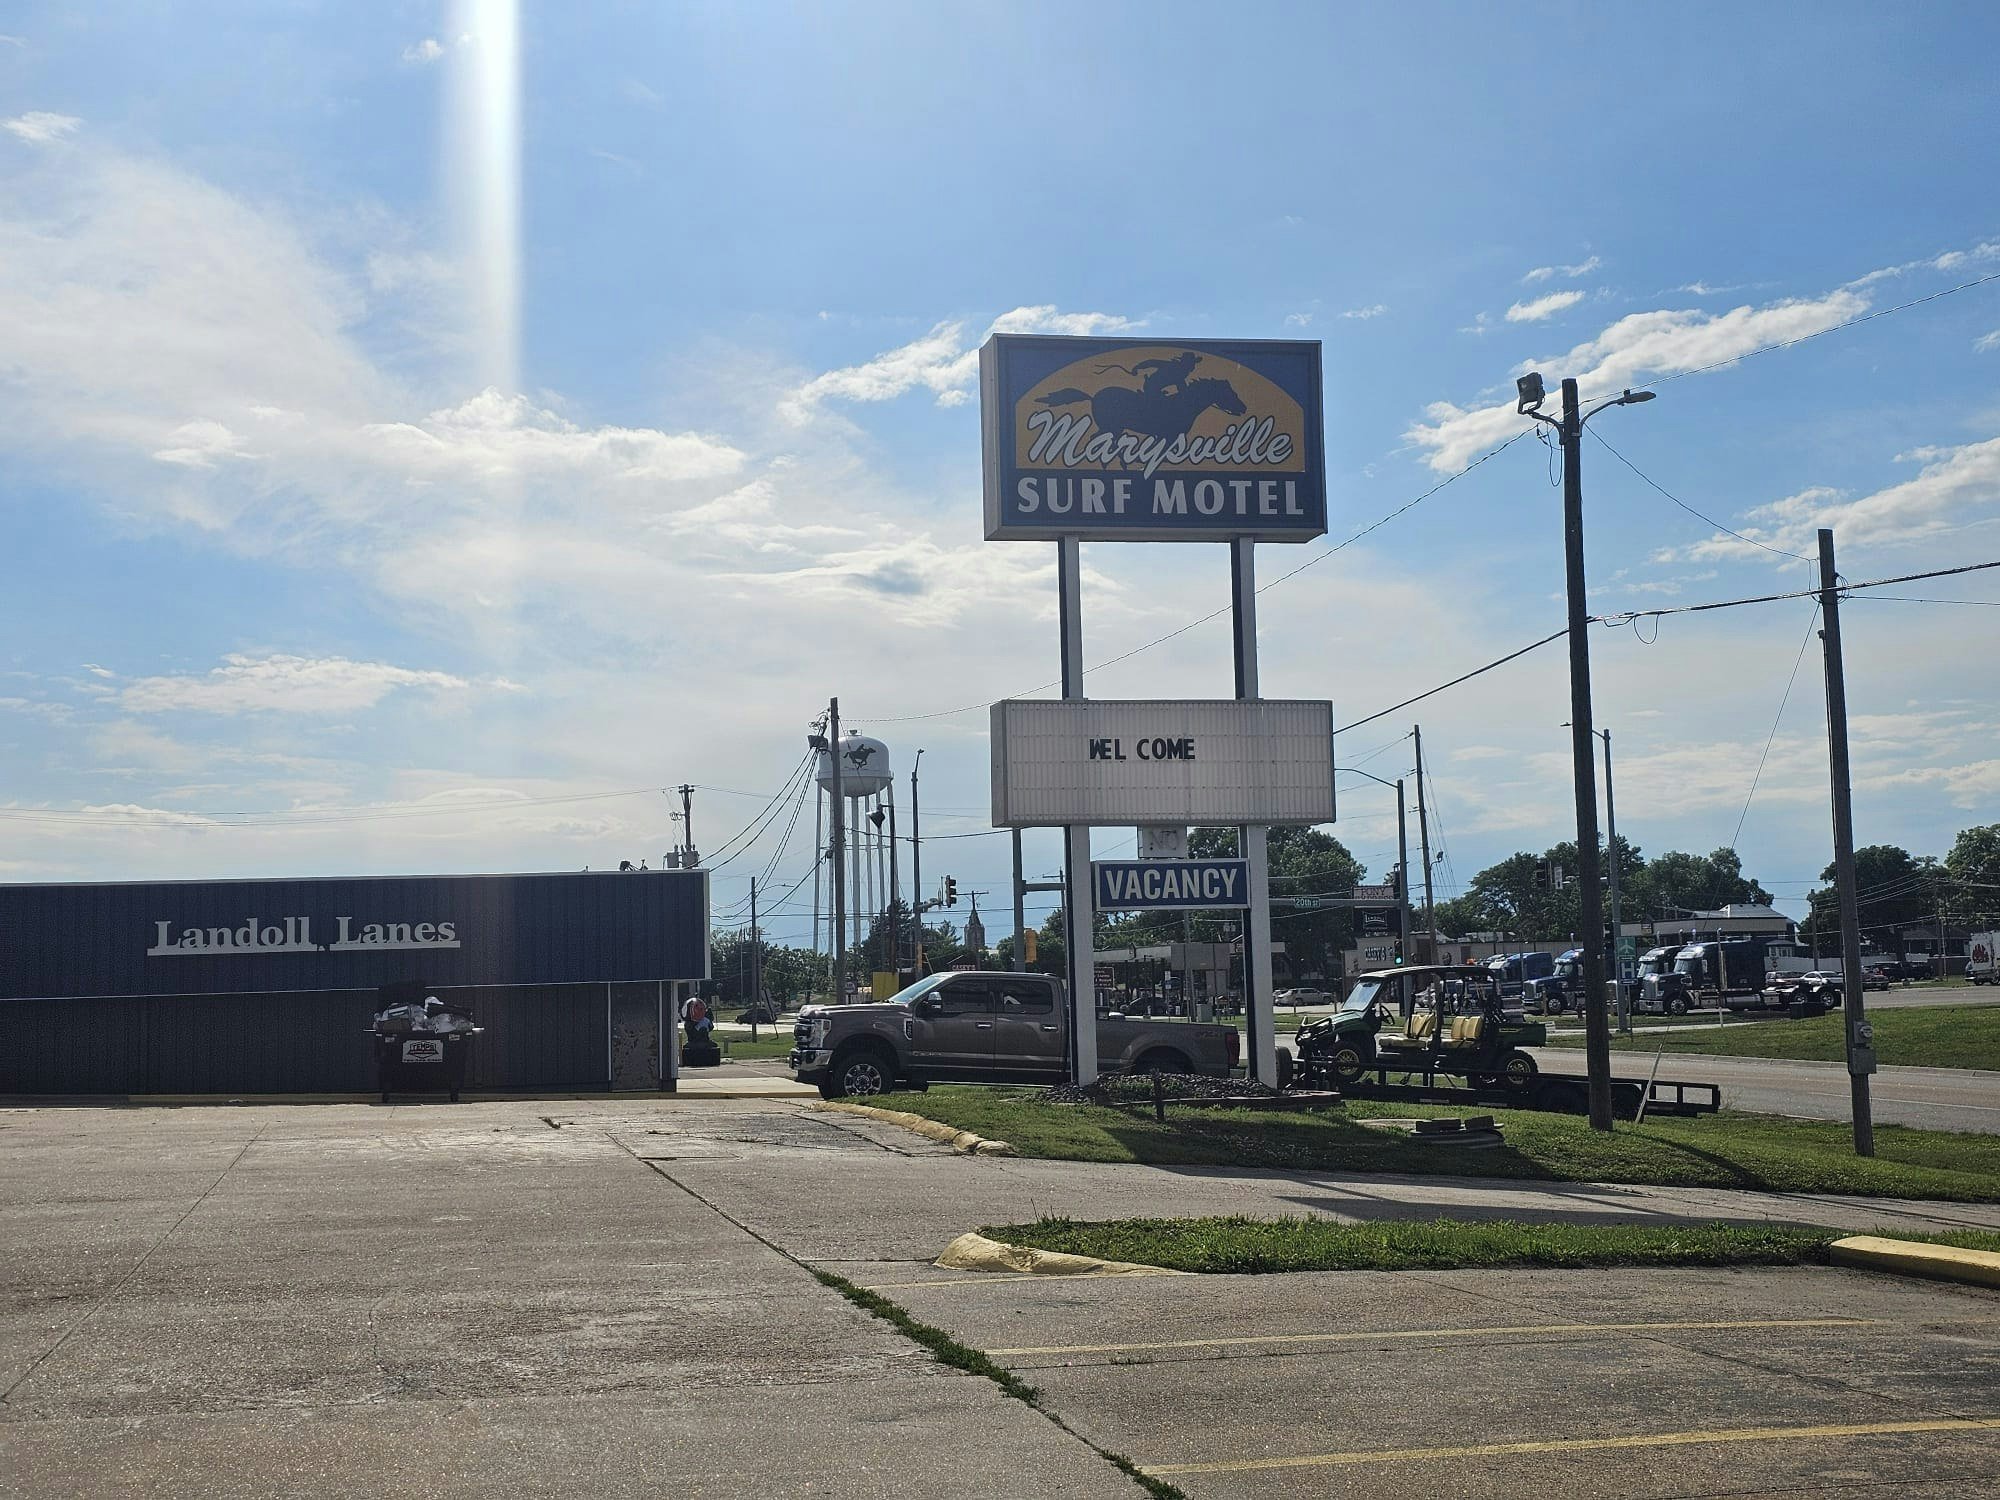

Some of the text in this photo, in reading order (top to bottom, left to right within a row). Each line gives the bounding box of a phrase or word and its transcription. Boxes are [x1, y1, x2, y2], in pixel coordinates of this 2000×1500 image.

[1027, 410, 1292, 480] Marysville
[1017, 477, 1304, 515] SURF MOTEL
[1105, 868, 1238, 901] VACANCY
[153, 916, 457, 952] Landoll Lanes
